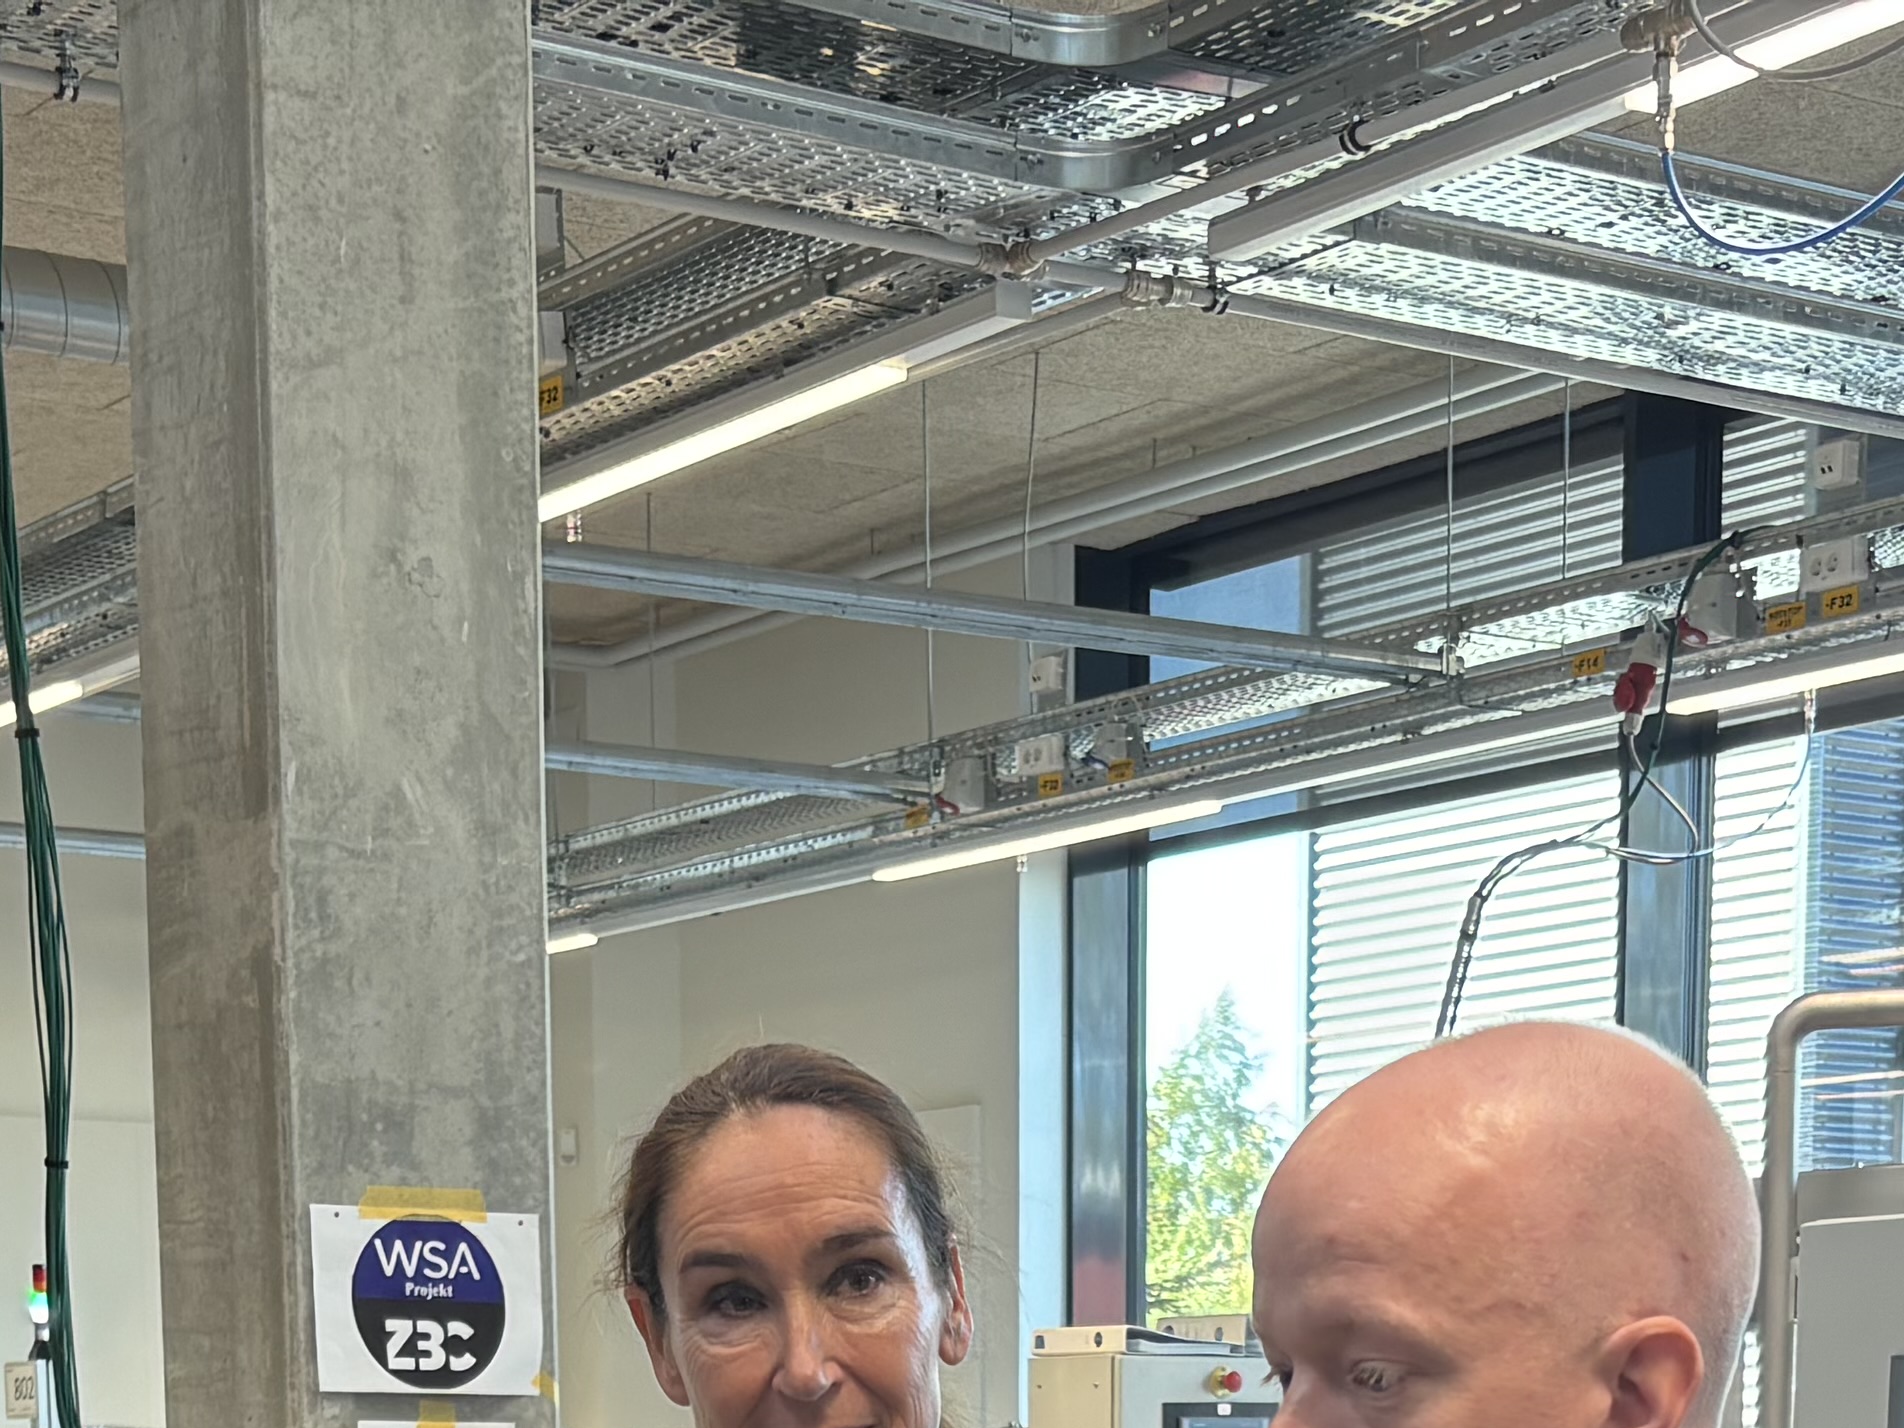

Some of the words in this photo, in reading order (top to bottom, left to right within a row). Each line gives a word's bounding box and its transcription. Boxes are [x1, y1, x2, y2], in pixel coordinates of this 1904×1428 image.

[373, 1238, 480, 1281] WSA
[405, 1281, 453, 1300] Projekt
[385, 1318, 477, 1372] ZBC
